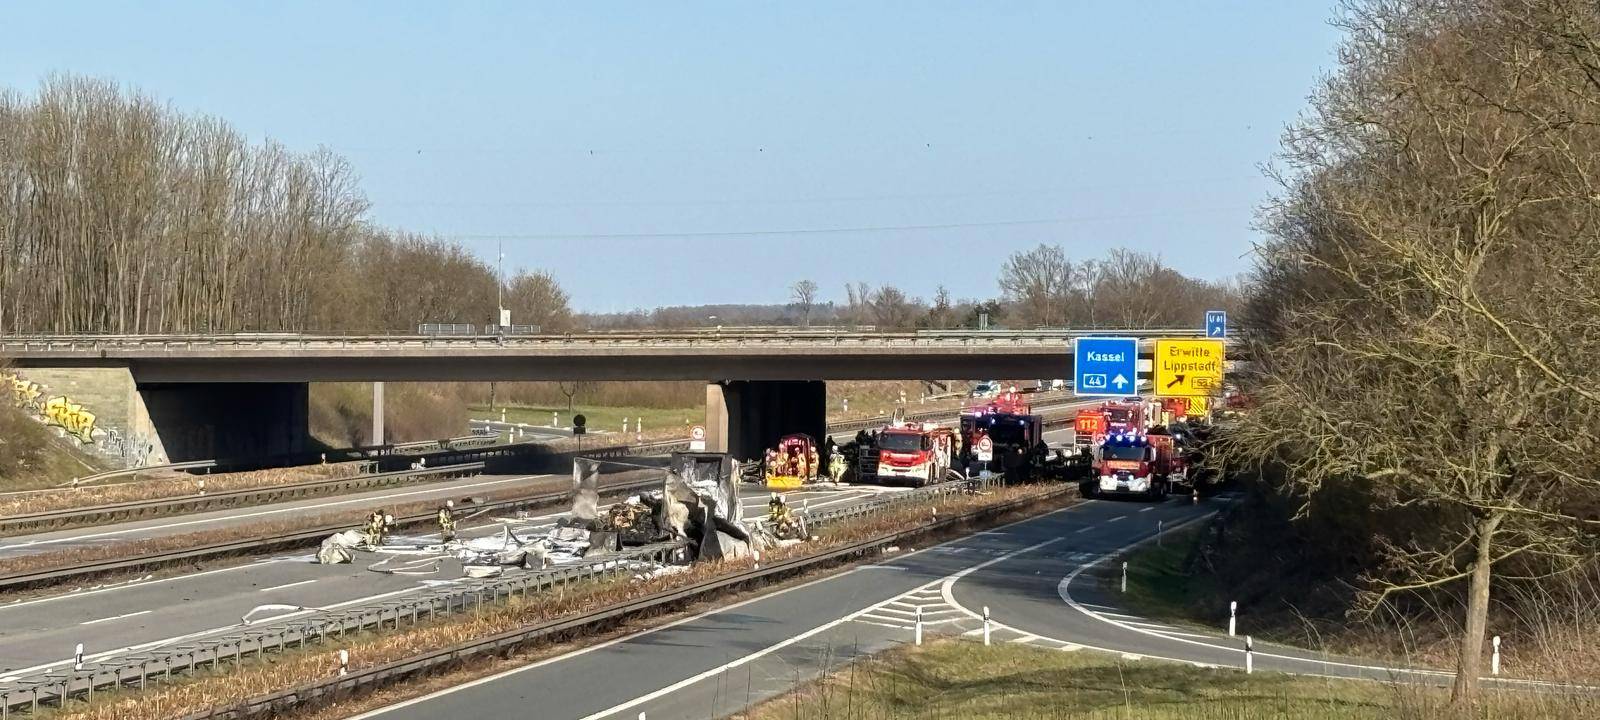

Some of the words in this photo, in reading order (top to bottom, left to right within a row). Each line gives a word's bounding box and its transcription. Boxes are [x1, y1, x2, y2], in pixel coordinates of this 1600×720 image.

[1209, 314, 1215, 323] U
[1087, 351, 1125, 362] Kassel
[1169, 346, 1210, 357] Erwitte
[1164, 360, 1216, 373] Lippstadt
[1089, 376, 1102, 386] 44
[1080, 419, 1098, 430] 112
